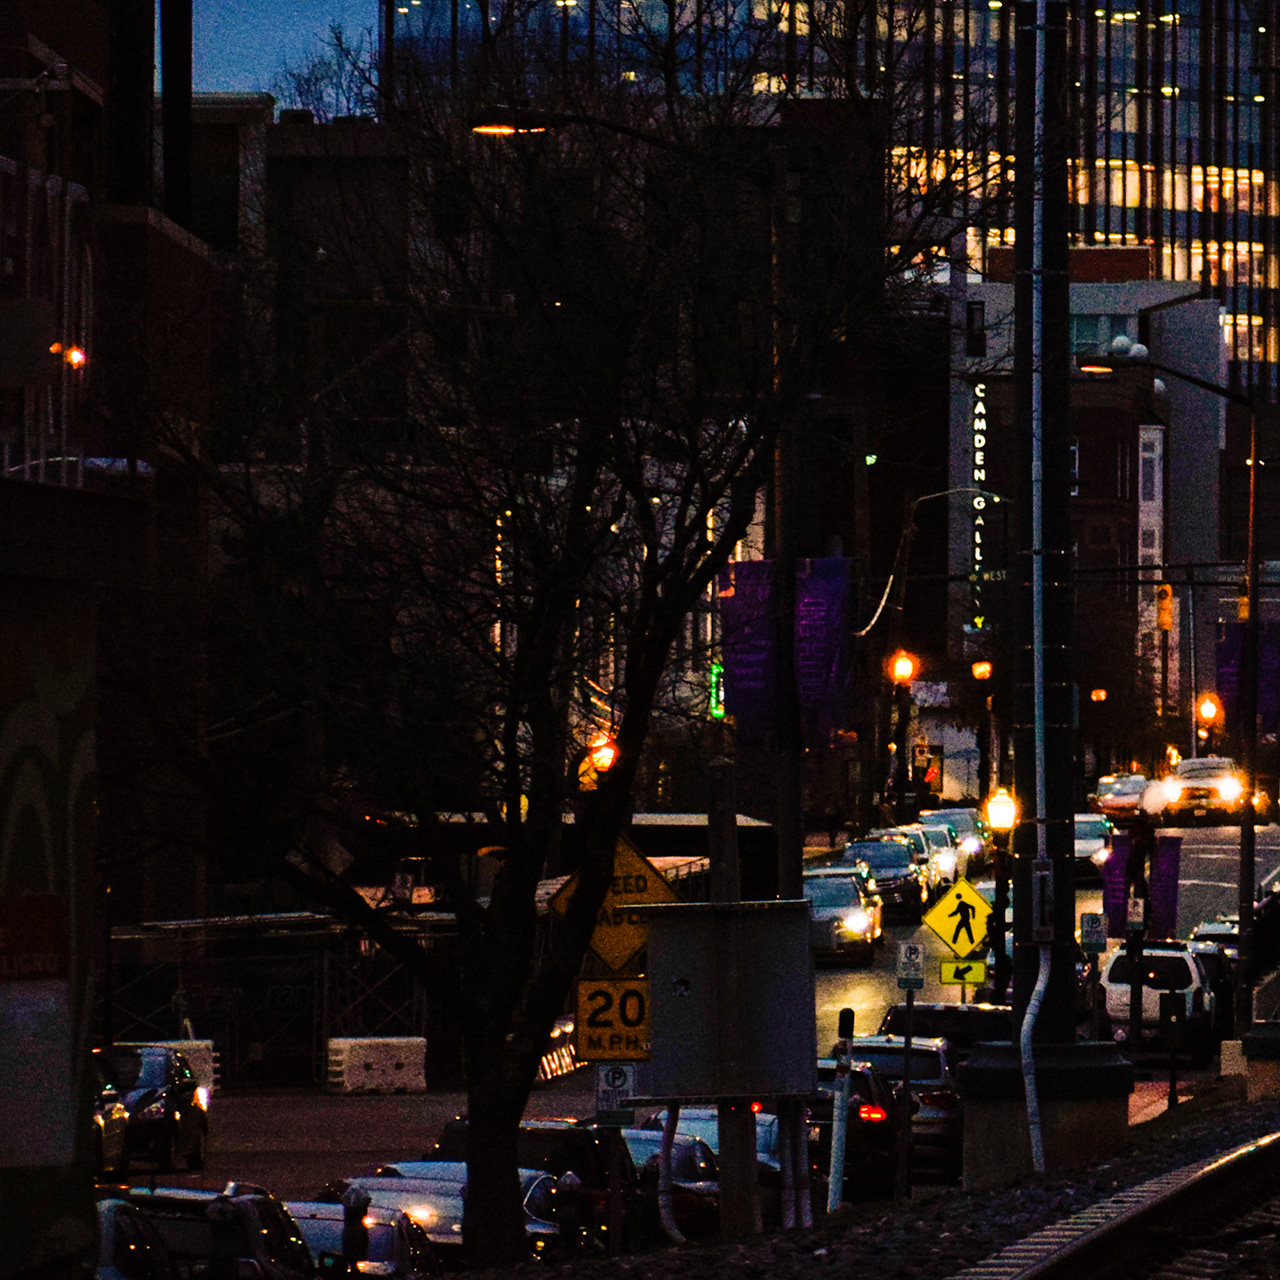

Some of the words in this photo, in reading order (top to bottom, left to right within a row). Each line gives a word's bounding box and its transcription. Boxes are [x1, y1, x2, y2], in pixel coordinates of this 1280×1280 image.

[973, 383, 987, 481] CAMDEN
[611, 875, 648, 894] EED
[586, 989, 645, 1028] 20
